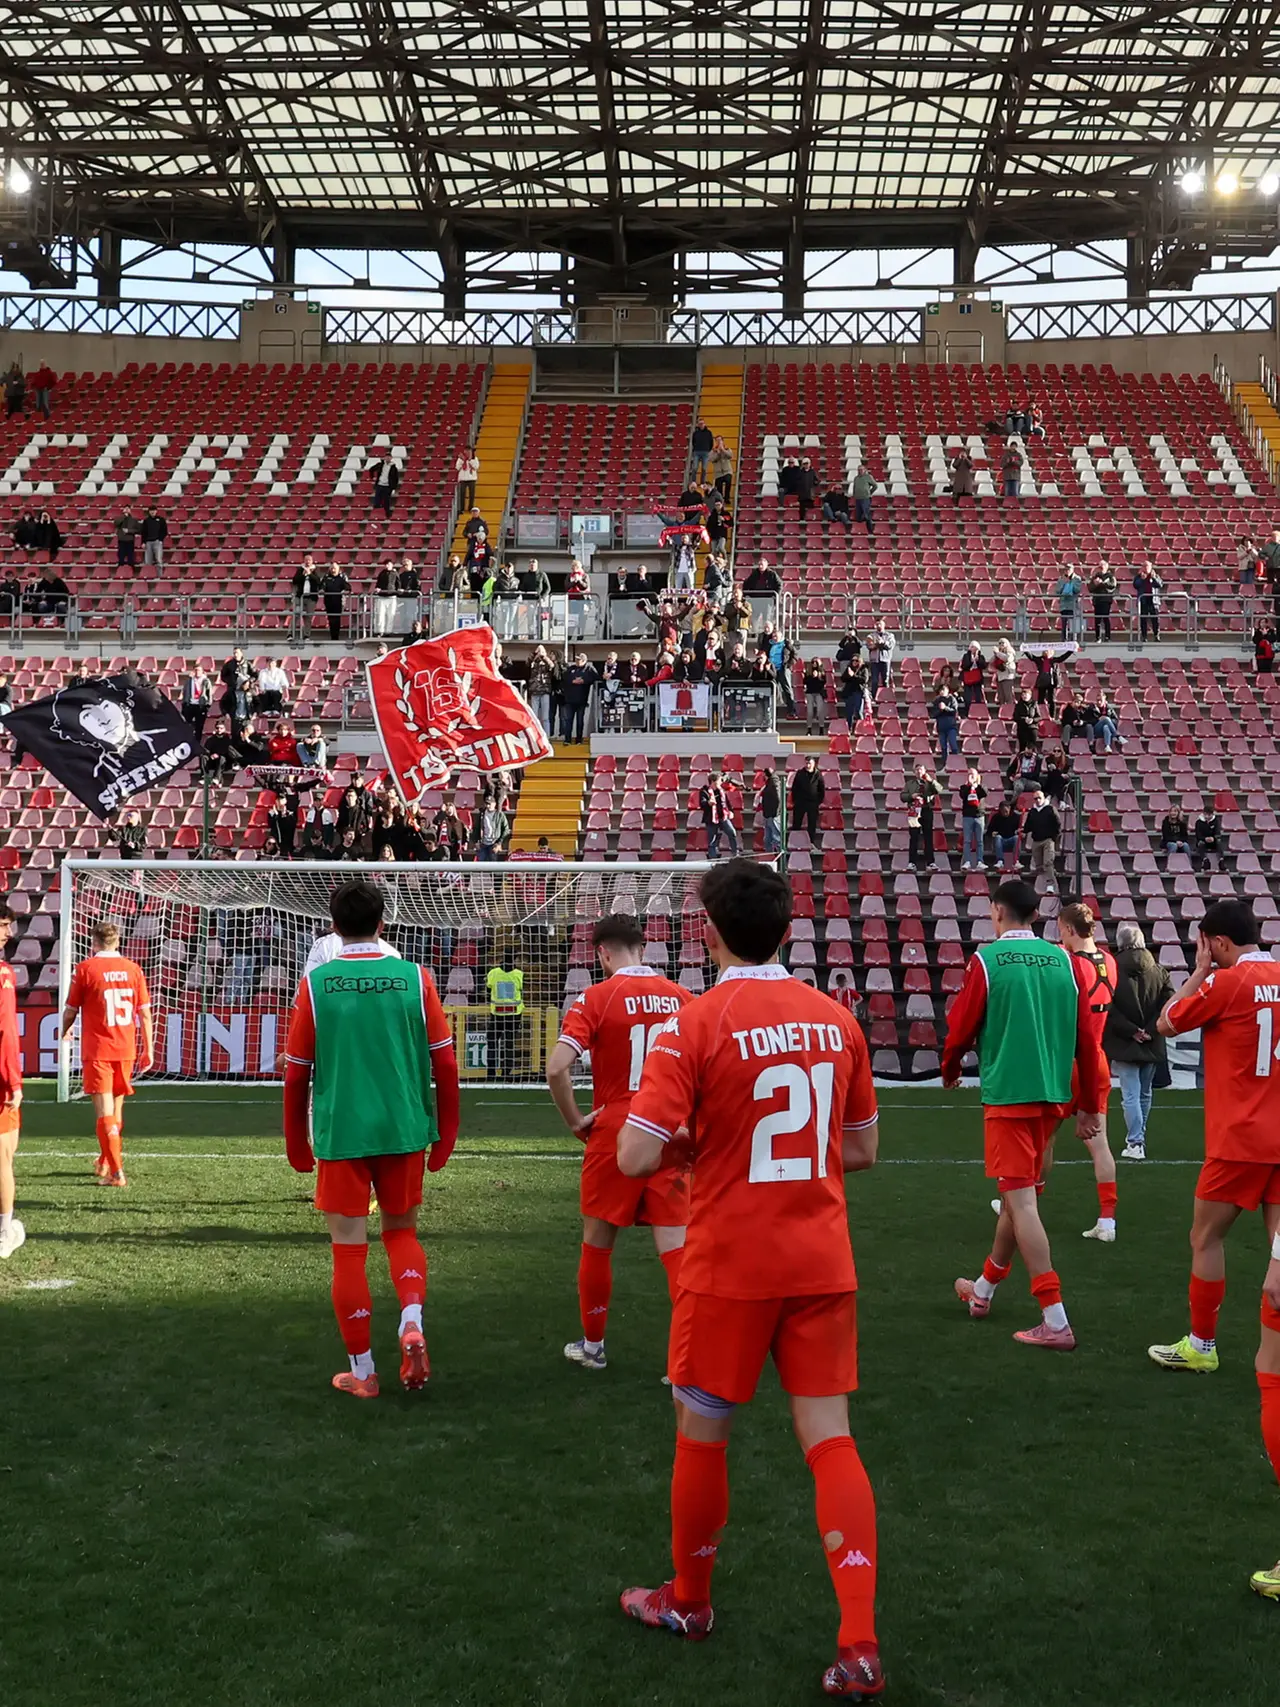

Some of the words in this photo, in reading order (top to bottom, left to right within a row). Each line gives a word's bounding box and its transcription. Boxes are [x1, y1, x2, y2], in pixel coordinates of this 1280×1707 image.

[589, 520, 597, 531] H
[98, 742, 191, 811] STEFANO
[996, 952, 1061, 967] Kappa
[324, 976, 408, 993] Kappa
[104, 988, 133, 1026] 15
[732, 1022, 843, 1060] TONETTO
[748, 1062, 834, 1184] 21
